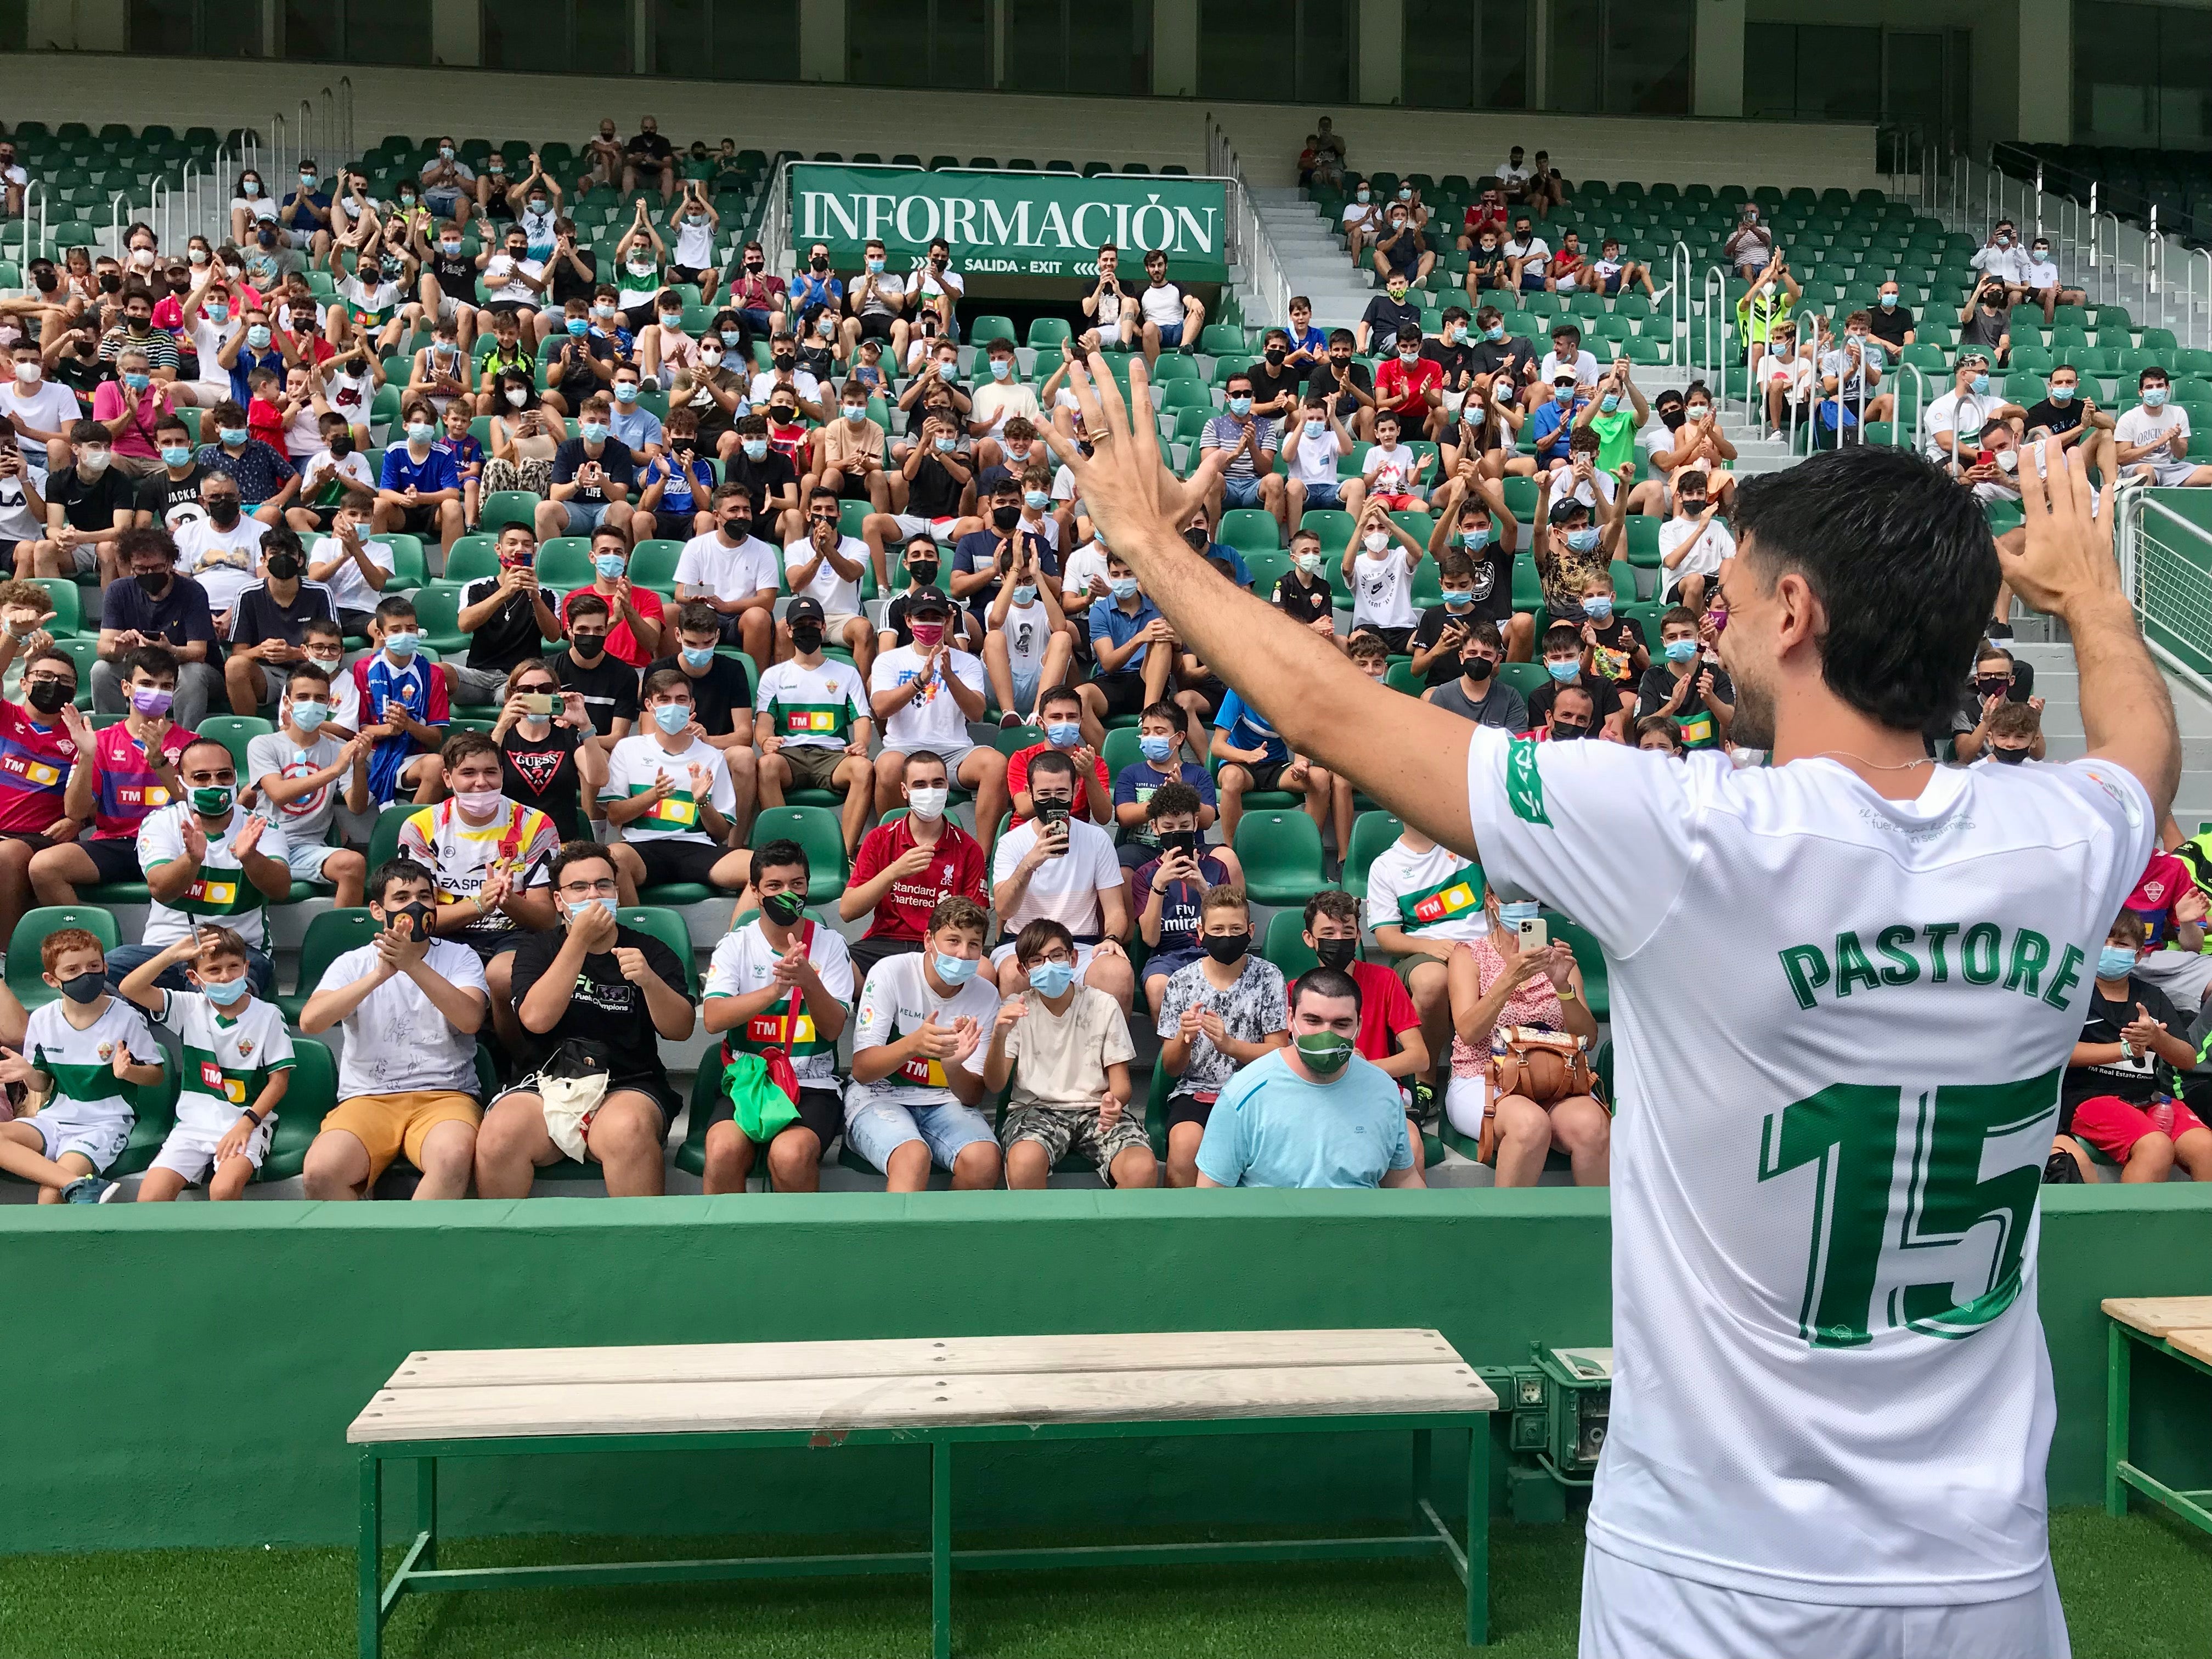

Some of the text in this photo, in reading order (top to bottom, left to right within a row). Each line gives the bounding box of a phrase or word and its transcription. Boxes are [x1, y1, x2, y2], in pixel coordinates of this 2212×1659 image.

[799, 192, 1218, 253] INFORMACIÓN
[964, 259, 1019, 273] SALIDA
[1030, 261, 1063, 274] EXIT
[586, 488, 601, 498] LIFE
[791, 716, 808, 726] TM
[4, 758, 25, 773] TM
[516, 754, 558, 768] GUESS
[121, 790, 141, 802] TM
[441, 878, 460, 889] EA
[893, 882, 936, 898] Standard
[1176, 904, 1195, 917] Fly
[1420, 900, 1441, 917] TM
[1778, 921, 2085, 1012] PASTORE
[754, 1021, 776, 1035] TM
[204, 1068, 222, 1085] TM
[907, 1060, 928, 1078] TM
[2099, 1067, 2114, 1075] Real
[2115, 1070, 2135, 1079] Estate
[1758, 1065, 2063, 1350] 15
